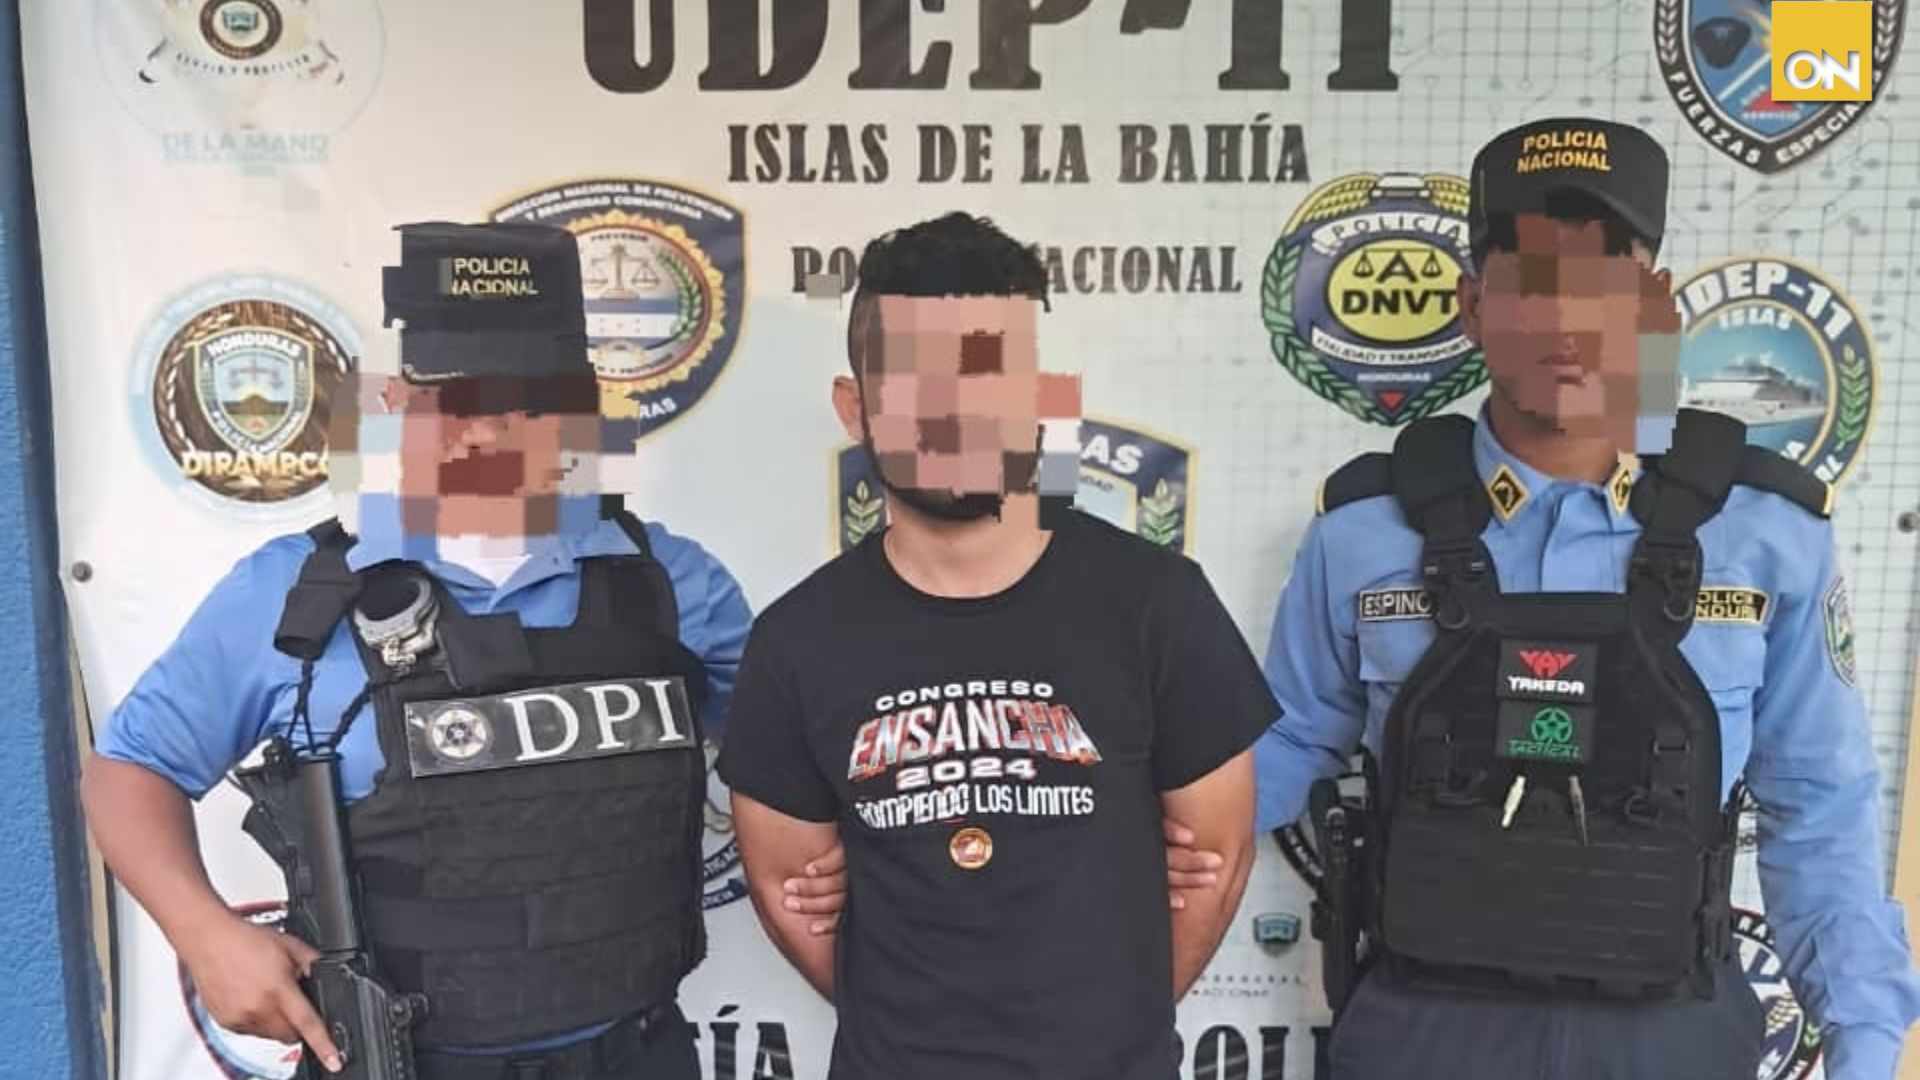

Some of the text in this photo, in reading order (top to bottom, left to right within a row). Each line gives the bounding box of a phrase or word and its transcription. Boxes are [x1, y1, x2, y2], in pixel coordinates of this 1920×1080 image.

[1669, 72, 1864, 164] FUERZAS ESPECIA
[727, 113, 1313, 184] ISLAS DE LA BAHÍA
[1523, 131, 1607, 153] POLICIA
[1517, 151, 1612, 173] NACIONAL
[1331, 215, 1464, 239] POLICIA
[455, 257, 531, 275] POLICIA
[1045, 246, 1242, 294] ACIONAL
[1341, 288, 1458, 316] DNVT
[876, 679, 1053, 712] CONGRESO
[503, 679, 686, 762] DPI
[848, 699, 1102, 782] ENSANCHA
[896, 756, 1036, 791] 2024
[975, 784, 1012, 814] LOS
[1016, 784, 1095, 816] LIMITES
